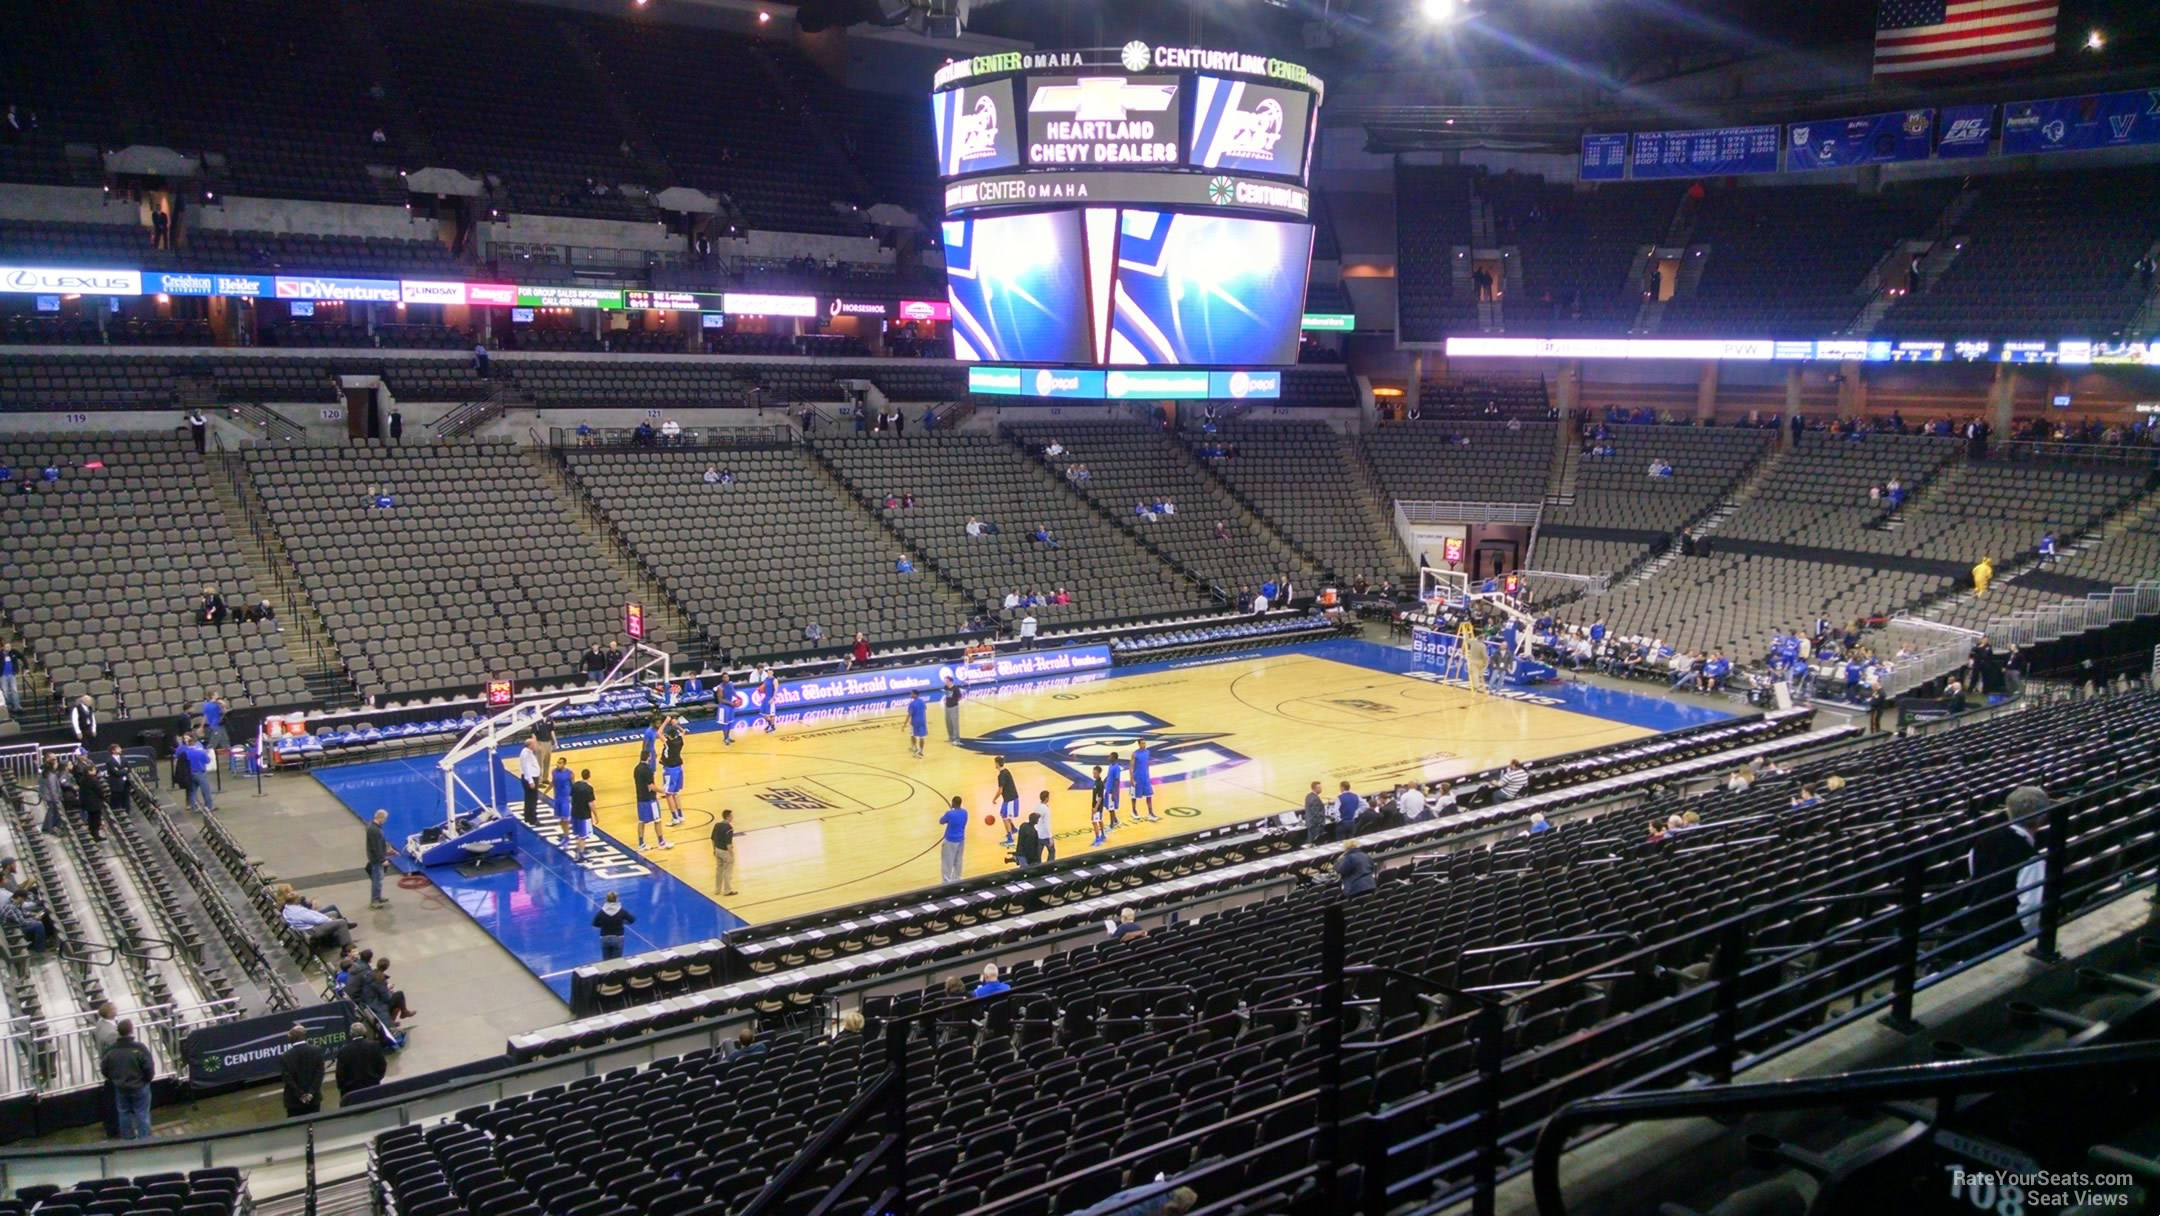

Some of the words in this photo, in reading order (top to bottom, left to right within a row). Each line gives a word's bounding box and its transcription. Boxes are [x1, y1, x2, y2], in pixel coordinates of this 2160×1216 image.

[973, 51, 1022, 75] CENTER
[1023, 52, 1083, 69] OMAHA
[1155, 47, 1267, 75] CENTURYLINK
[1267, 58, 1308, 84] CENTER
[1047, 121, 1154, 141] HEARTLAND
[1951, 118, 1984, 130] BIG
[1946, 128, 1991, 139] EAST
[1030, 143, 1090, 162] CHEVY
[1094, 142, 1177, 163] DEALERS
[979, 181, 1026, 200] CENTER
[1028, 184, 1088, 198] OMAHA
[42, 275, 130, 289] LEXUS
[161, 274, 211, 289] Creighton
[217, 278, 260, 291] Heider
[302, 279, 399, 300] DiVentures
[415, 286, 458, 295] LINDSAY
[518, 288, 532, 297] FOR
[532, 288, 556, 298] GROUP
[557, 289, 577, 299] SALES
[578, 289, 620, 300] INFORMATION
[541, 297, 558, 306] CALL
[1724, 343, 1758, 355] PVW
[1051, 375, 1078, 390] pepsi
[1249, 378, 1276, 392] pepsi
[319, 409, 341, 420] 120
[647, 408, 662, 418] 121
[838, 406, 851, 416] 122
[66, 413, 87, 424] 119
[997, 654, 1071, 676] World-Herald
[801, 675, 888, 700] World-Herald
[306, 1031, 347, 1047] CENTER
